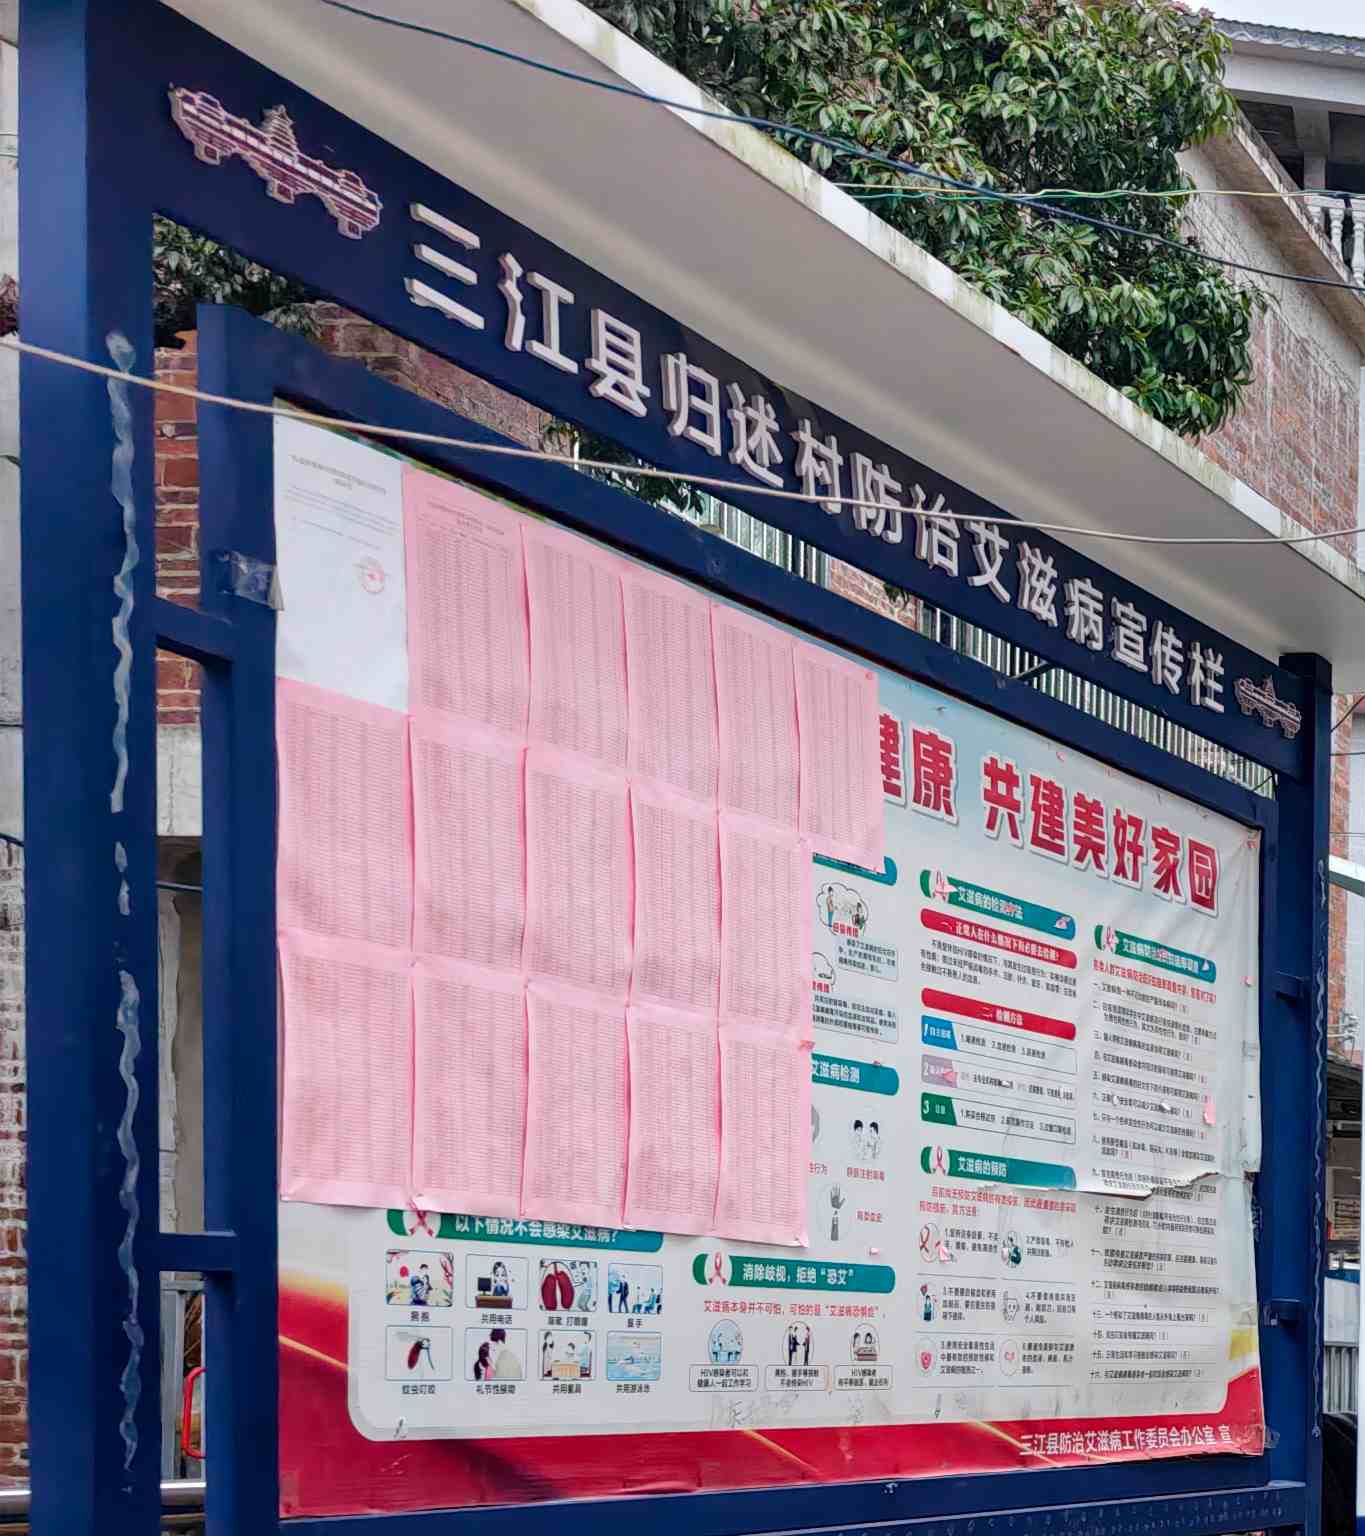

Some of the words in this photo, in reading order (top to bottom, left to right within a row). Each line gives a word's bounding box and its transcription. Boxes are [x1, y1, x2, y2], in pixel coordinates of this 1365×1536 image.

[405, 202, 1228, 717] 三江县归述村防治艾滋病宣传栏
[982, 756, 1220, 911] 共建美好家园
[957, 1156, 1008, 1178] 艾滋病的预防
